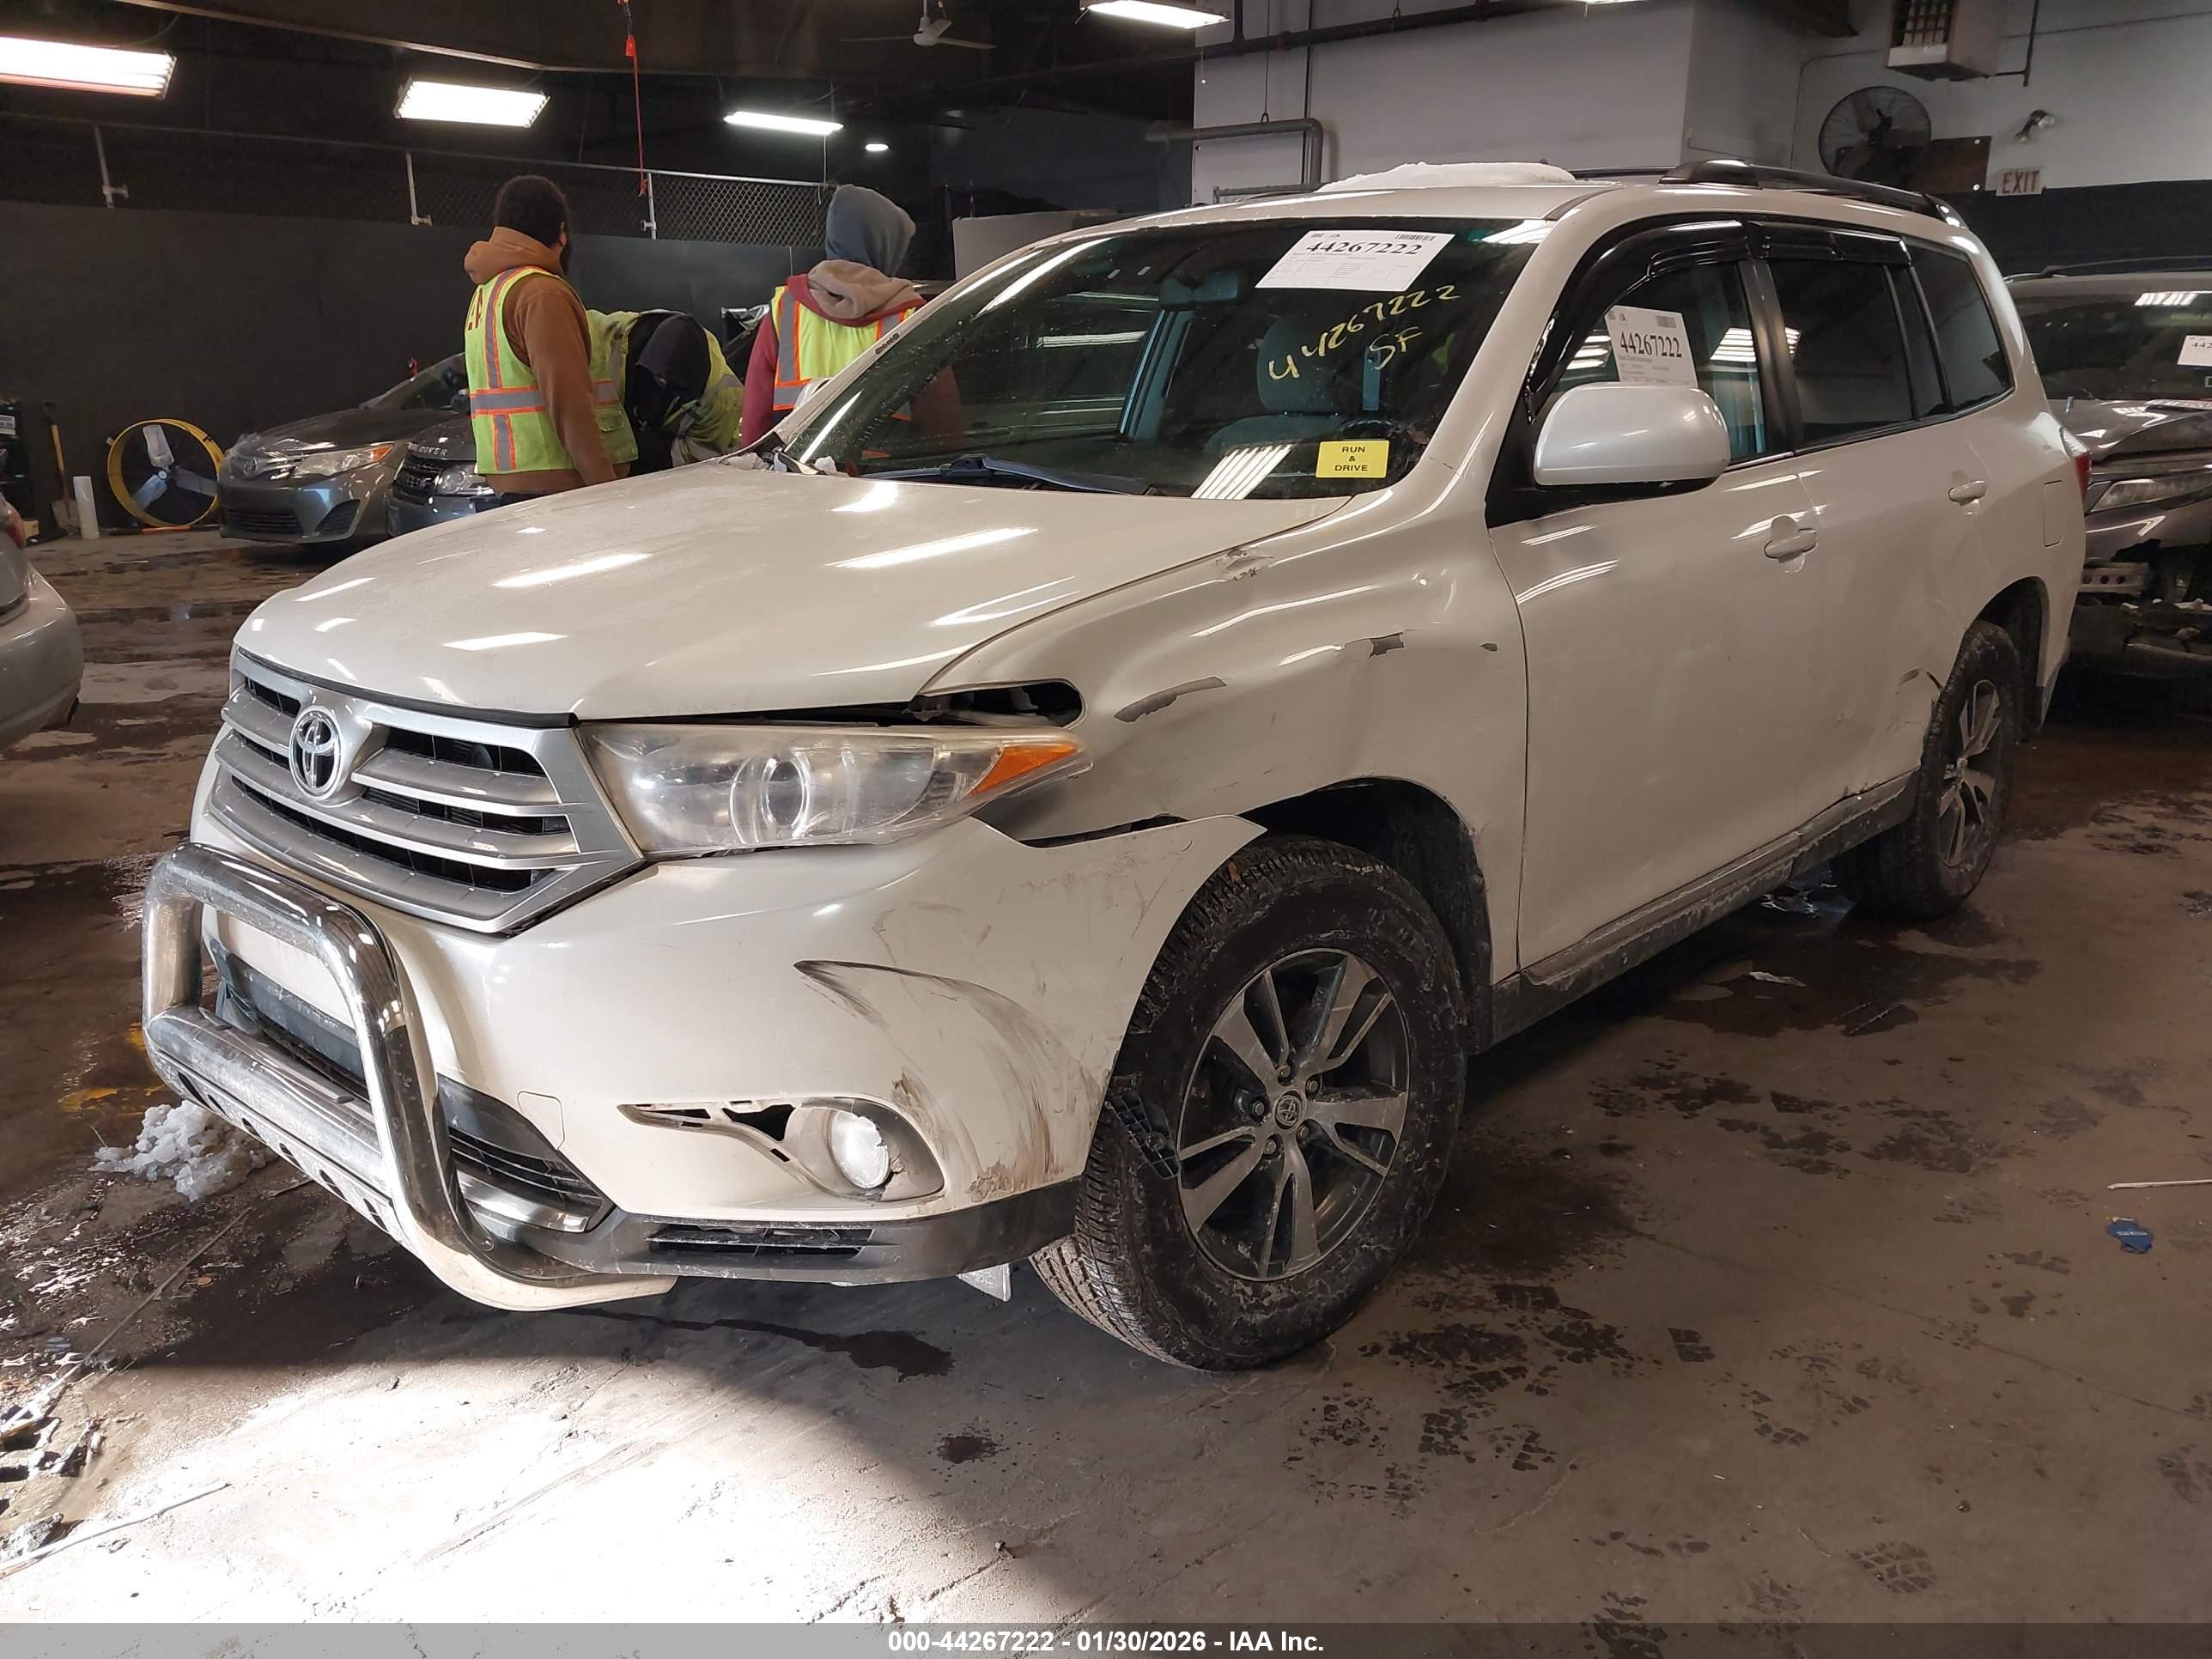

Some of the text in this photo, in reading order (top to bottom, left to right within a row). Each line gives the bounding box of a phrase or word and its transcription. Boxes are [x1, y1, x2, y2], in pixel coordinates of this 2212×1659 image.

[2002, 171, 2040, 193] EXIT
[1305, 241, 1423, 255] 44267222
[1370, 326, 1423, 371] SF
[1620, 331, 1683, 358] 44267222
